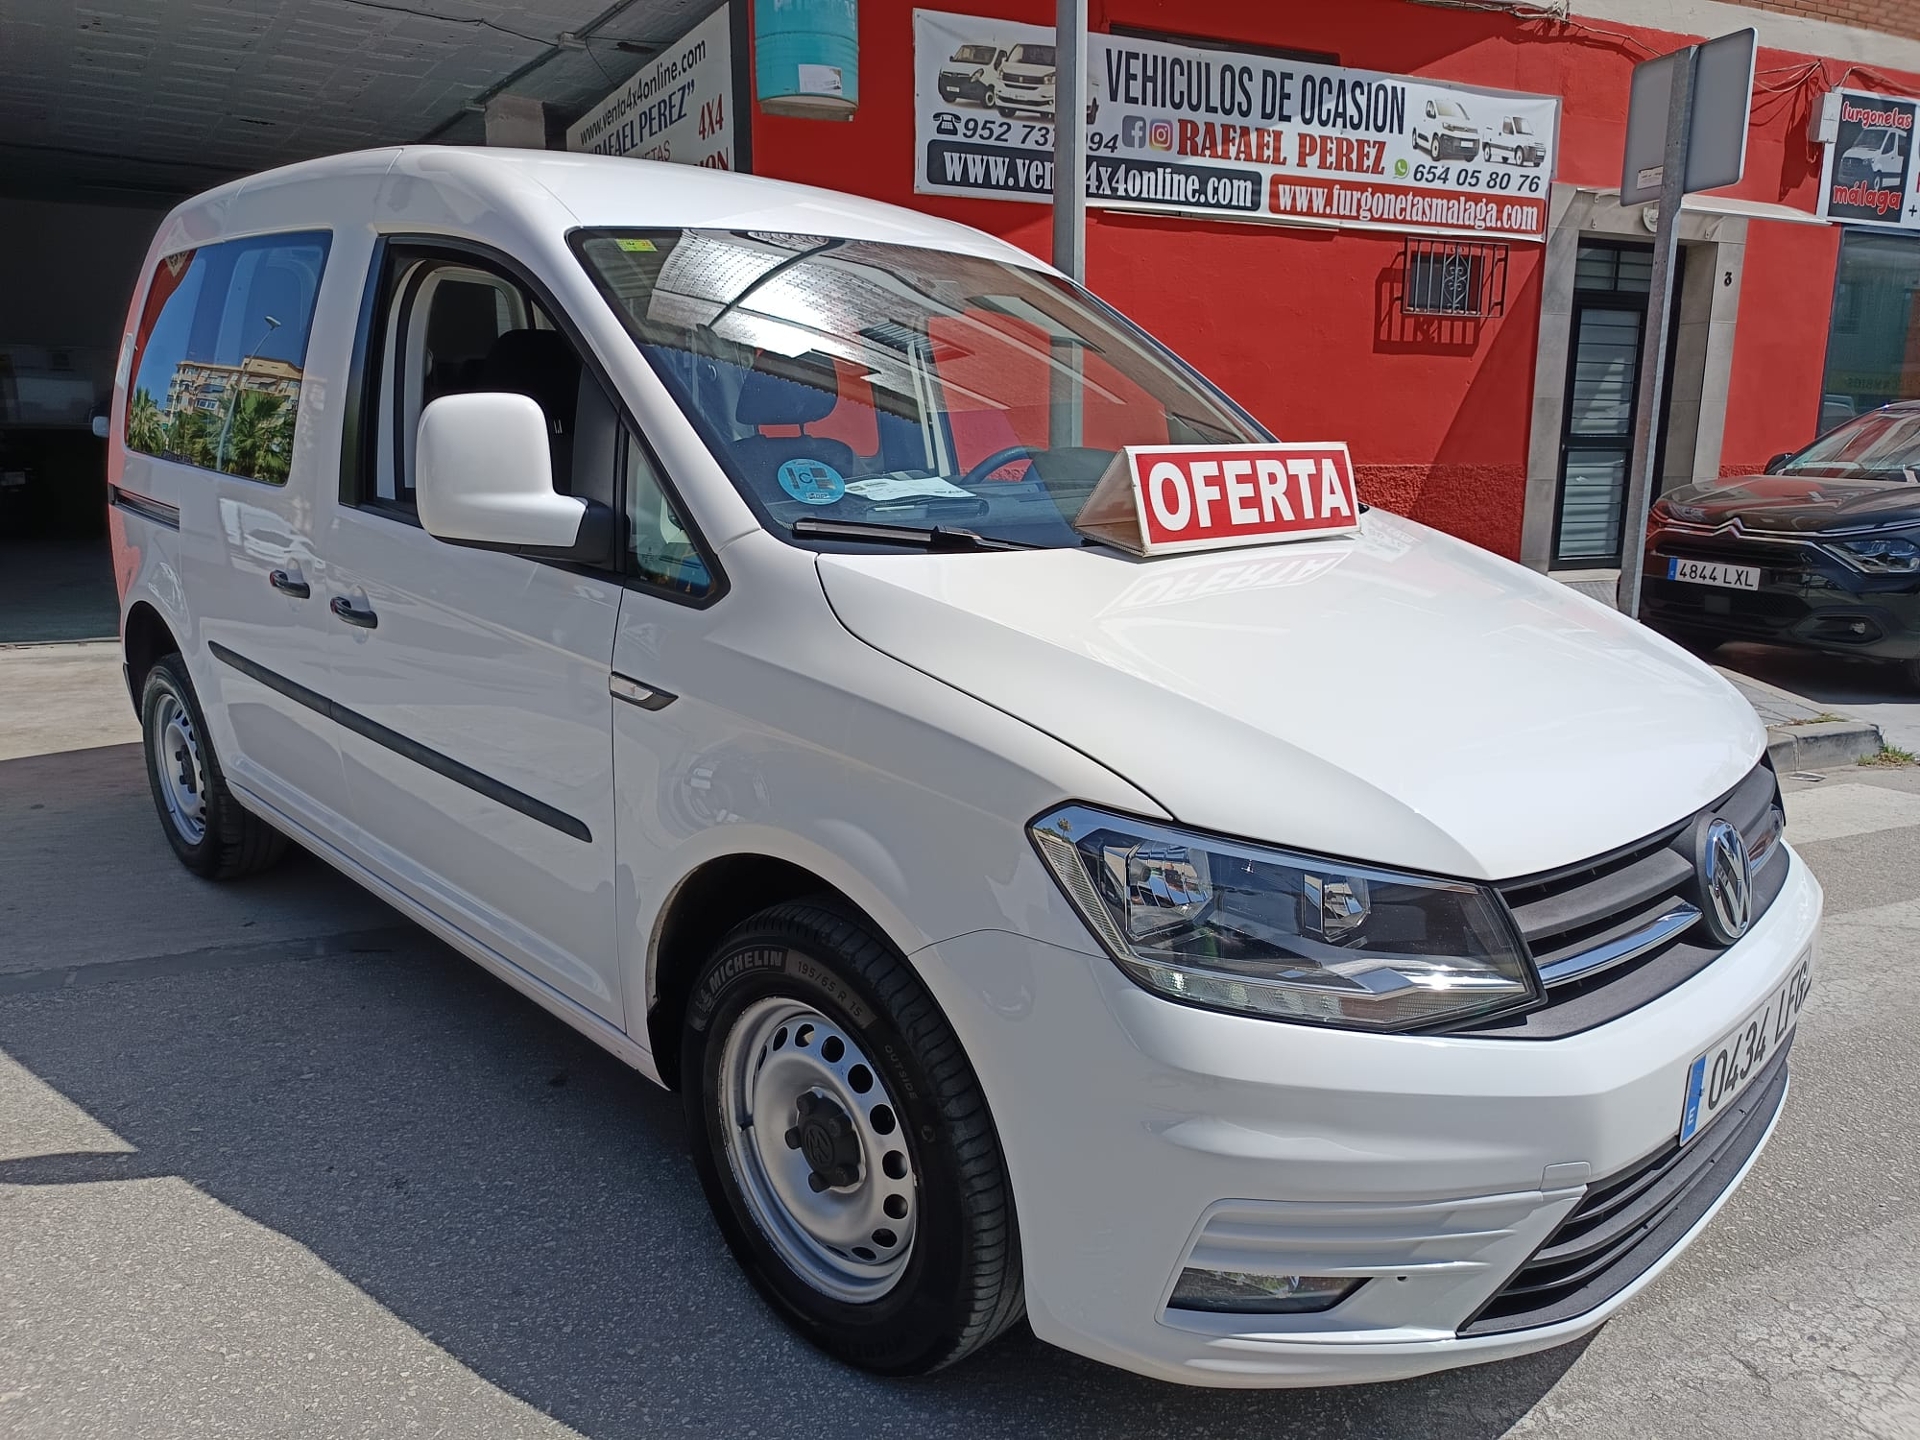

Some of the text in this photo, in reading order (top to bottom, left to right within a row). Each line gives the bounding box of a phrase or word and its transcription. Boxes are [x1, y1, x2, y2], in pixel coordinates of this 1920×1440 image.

[580, 40, 706, 146] www.venta4x4online.com
[1105, 48, 1406, 134] VEHICULOS DE OCASION
[1842, 101, 1912, 129] furgonetas
[698, 93, 724, 141] 4X4
[963, 118, 1120, 153] 952 73 94
[1177, 119, 1387, 175] RAFAEL PEREZ
[943, 151, 1253, 207] www.ven4x4online.com
[1413, 164, 1541, 193] 654 05 80 76
[1278, 183, 1538, 231] www.furgonetasmalaga.com
[1724, 271, 1733, 287] 3
[1148, 458, 1352, 532] OFERTA
[1679, 562, 1754, 588] 4844 LXL
[708, 949, 783, 994] MICHELIN
[797, 960, 837, 993] 195/65
[837, 990, 848, 1002] R
[1708, 1006, 1770, 1111] 0434
